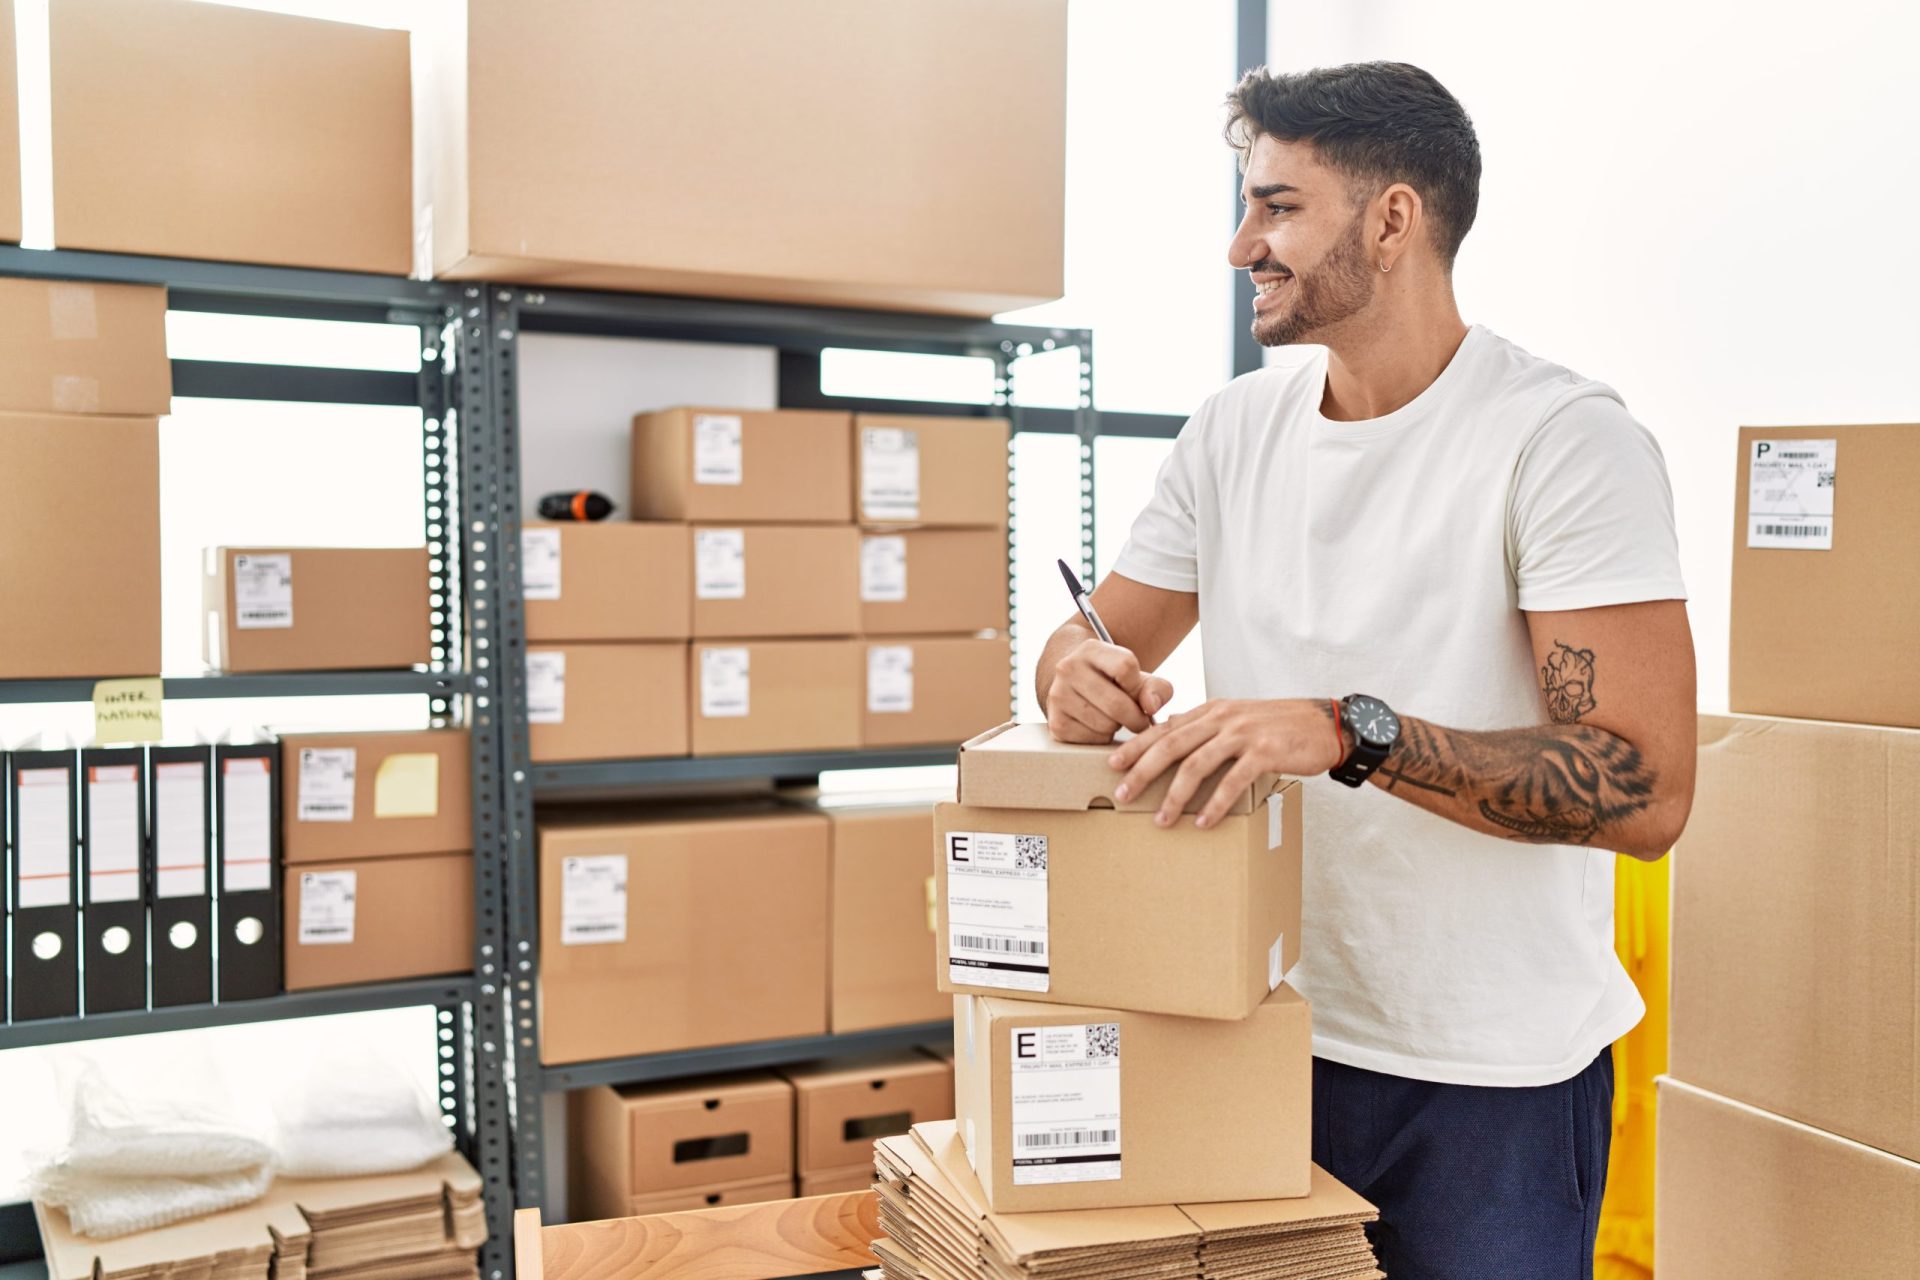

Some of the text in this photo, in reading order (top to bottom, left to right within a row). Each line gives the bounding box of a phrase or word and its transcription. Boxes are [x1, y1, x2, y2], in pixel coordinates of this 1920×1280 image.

[1757, 442, 1771, 459] P
[951, 836, 969, 862] E
[1017, 1033, 1036, 1058] E
